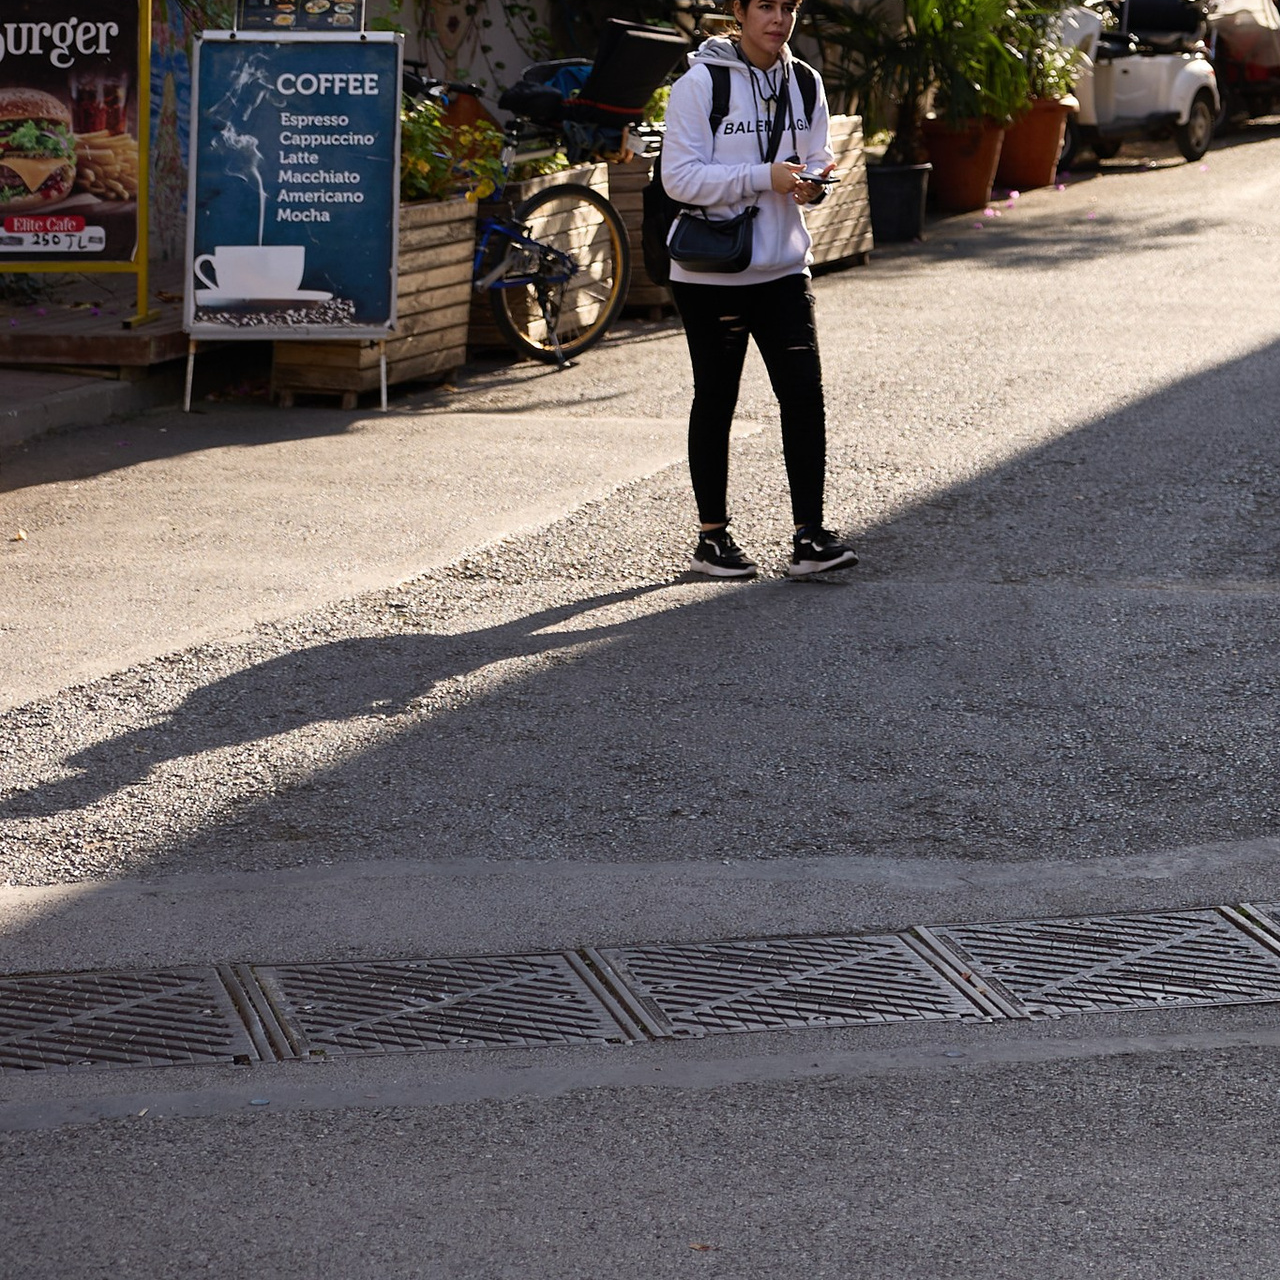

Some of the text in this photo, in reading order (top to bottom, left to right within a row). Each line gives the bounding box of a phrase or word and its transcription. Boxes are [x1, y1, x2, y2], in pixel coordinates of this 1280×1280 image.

[0, 17, 119, 69] urger
[276, 73, 379, 95] COFFEE
[280, 112, 349, 129] Espresso
[279, 131, 375, 148] Cappuccino
[279, 150, 319, 164] Latte
[278, 170, 361, 183] Macchiato
[277, 189, 364, 203] Americano
[276, 208, 330, 222] Mocha
[13, 217, 77, 231] Elite Cafe
[32, 232, 87, 251] 250 TL
